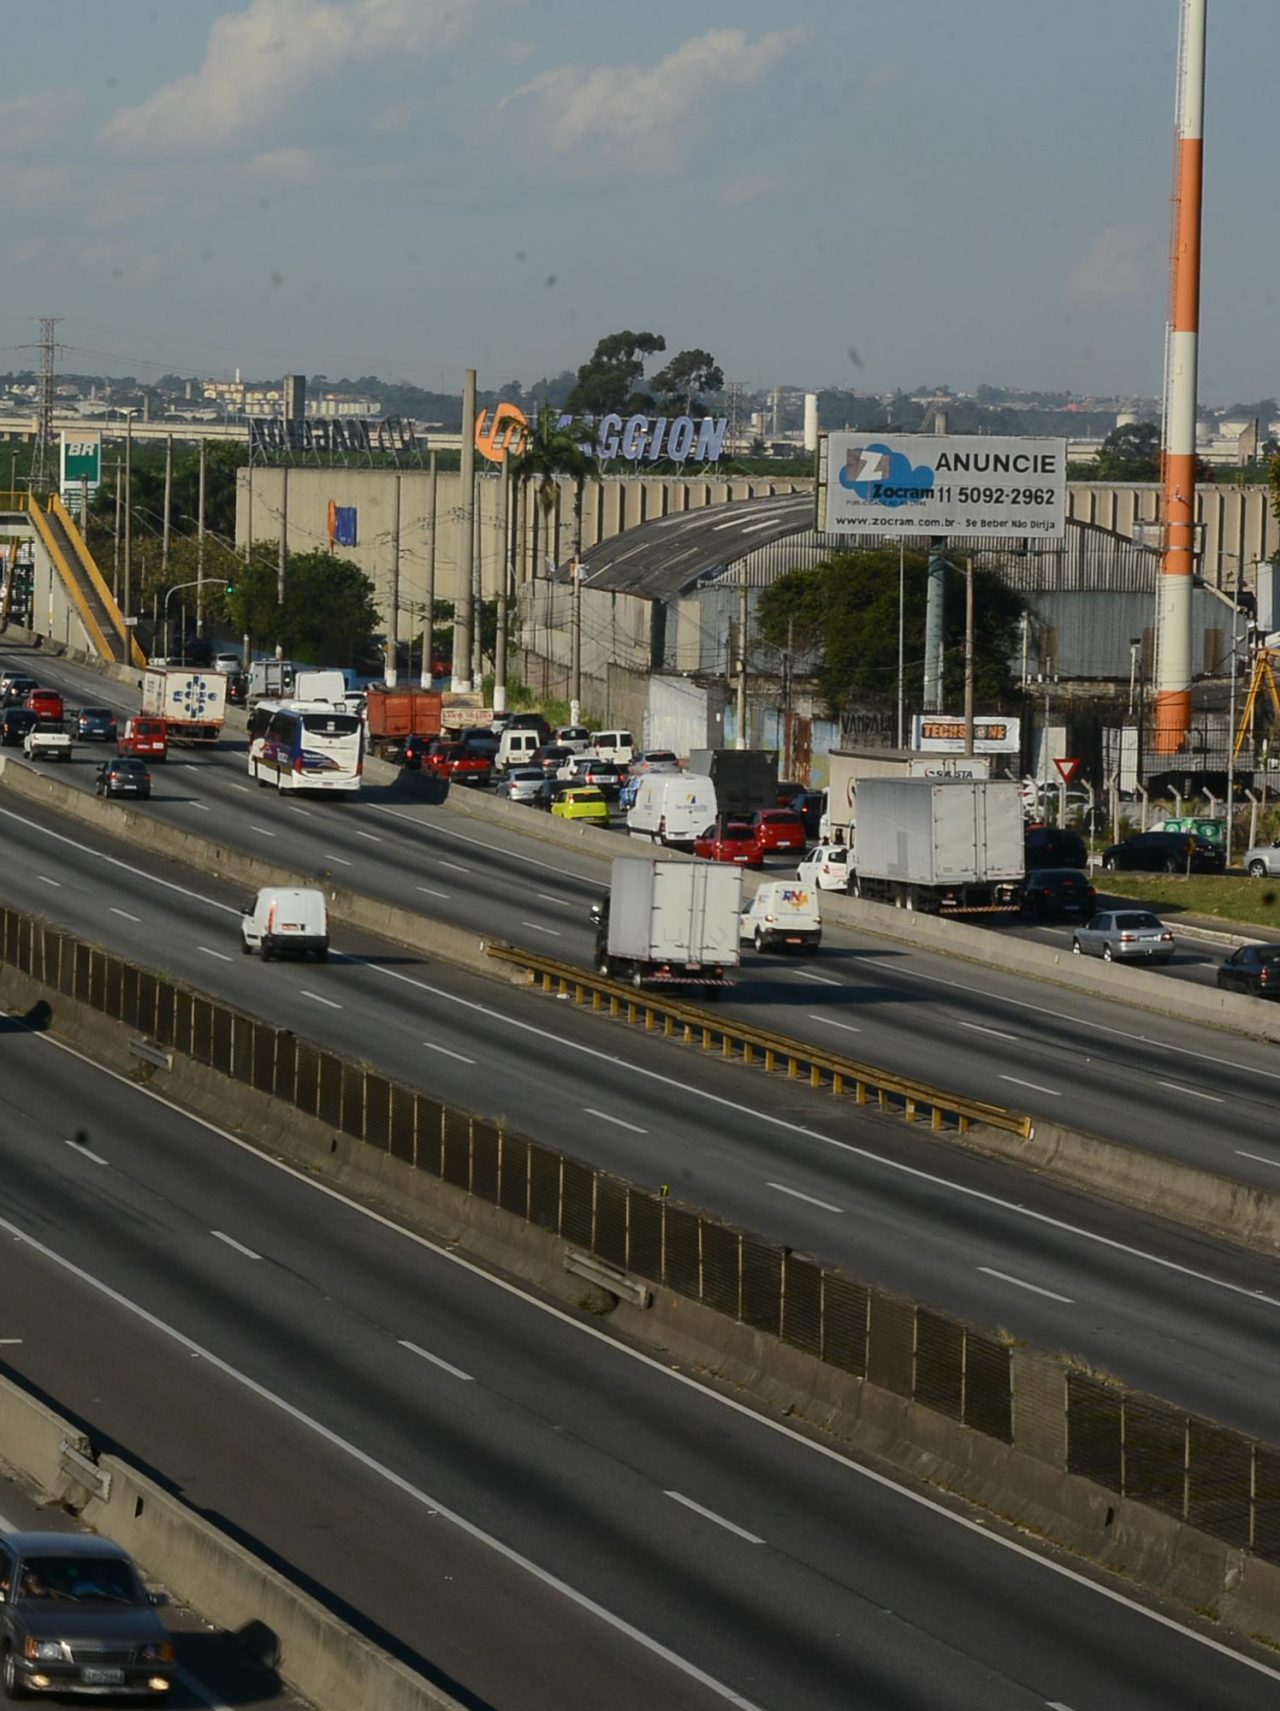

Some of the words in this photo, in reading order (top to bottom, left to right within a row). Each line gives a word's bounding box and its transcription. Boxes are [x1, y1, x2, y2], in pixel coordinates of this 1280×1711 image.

[68, 443, 96, 456] BR
[935, 452, 1056, 473] ANUNCIE
[872, 484, 934, 500] Zocram
[938, 488, 951, 503] 11
[958, 487, 1055, 505] 5092-2962
[836, 517, 955, 527] www.zocram.com.br
[965, 518, 977, 528] Se
[981, 519, 1008, 528] Beber
[1011, 519, 1027, 529] Não
[1030, 520, 1055, 531] Dirija
[923, 723, 1005, 739] TECHSONE
